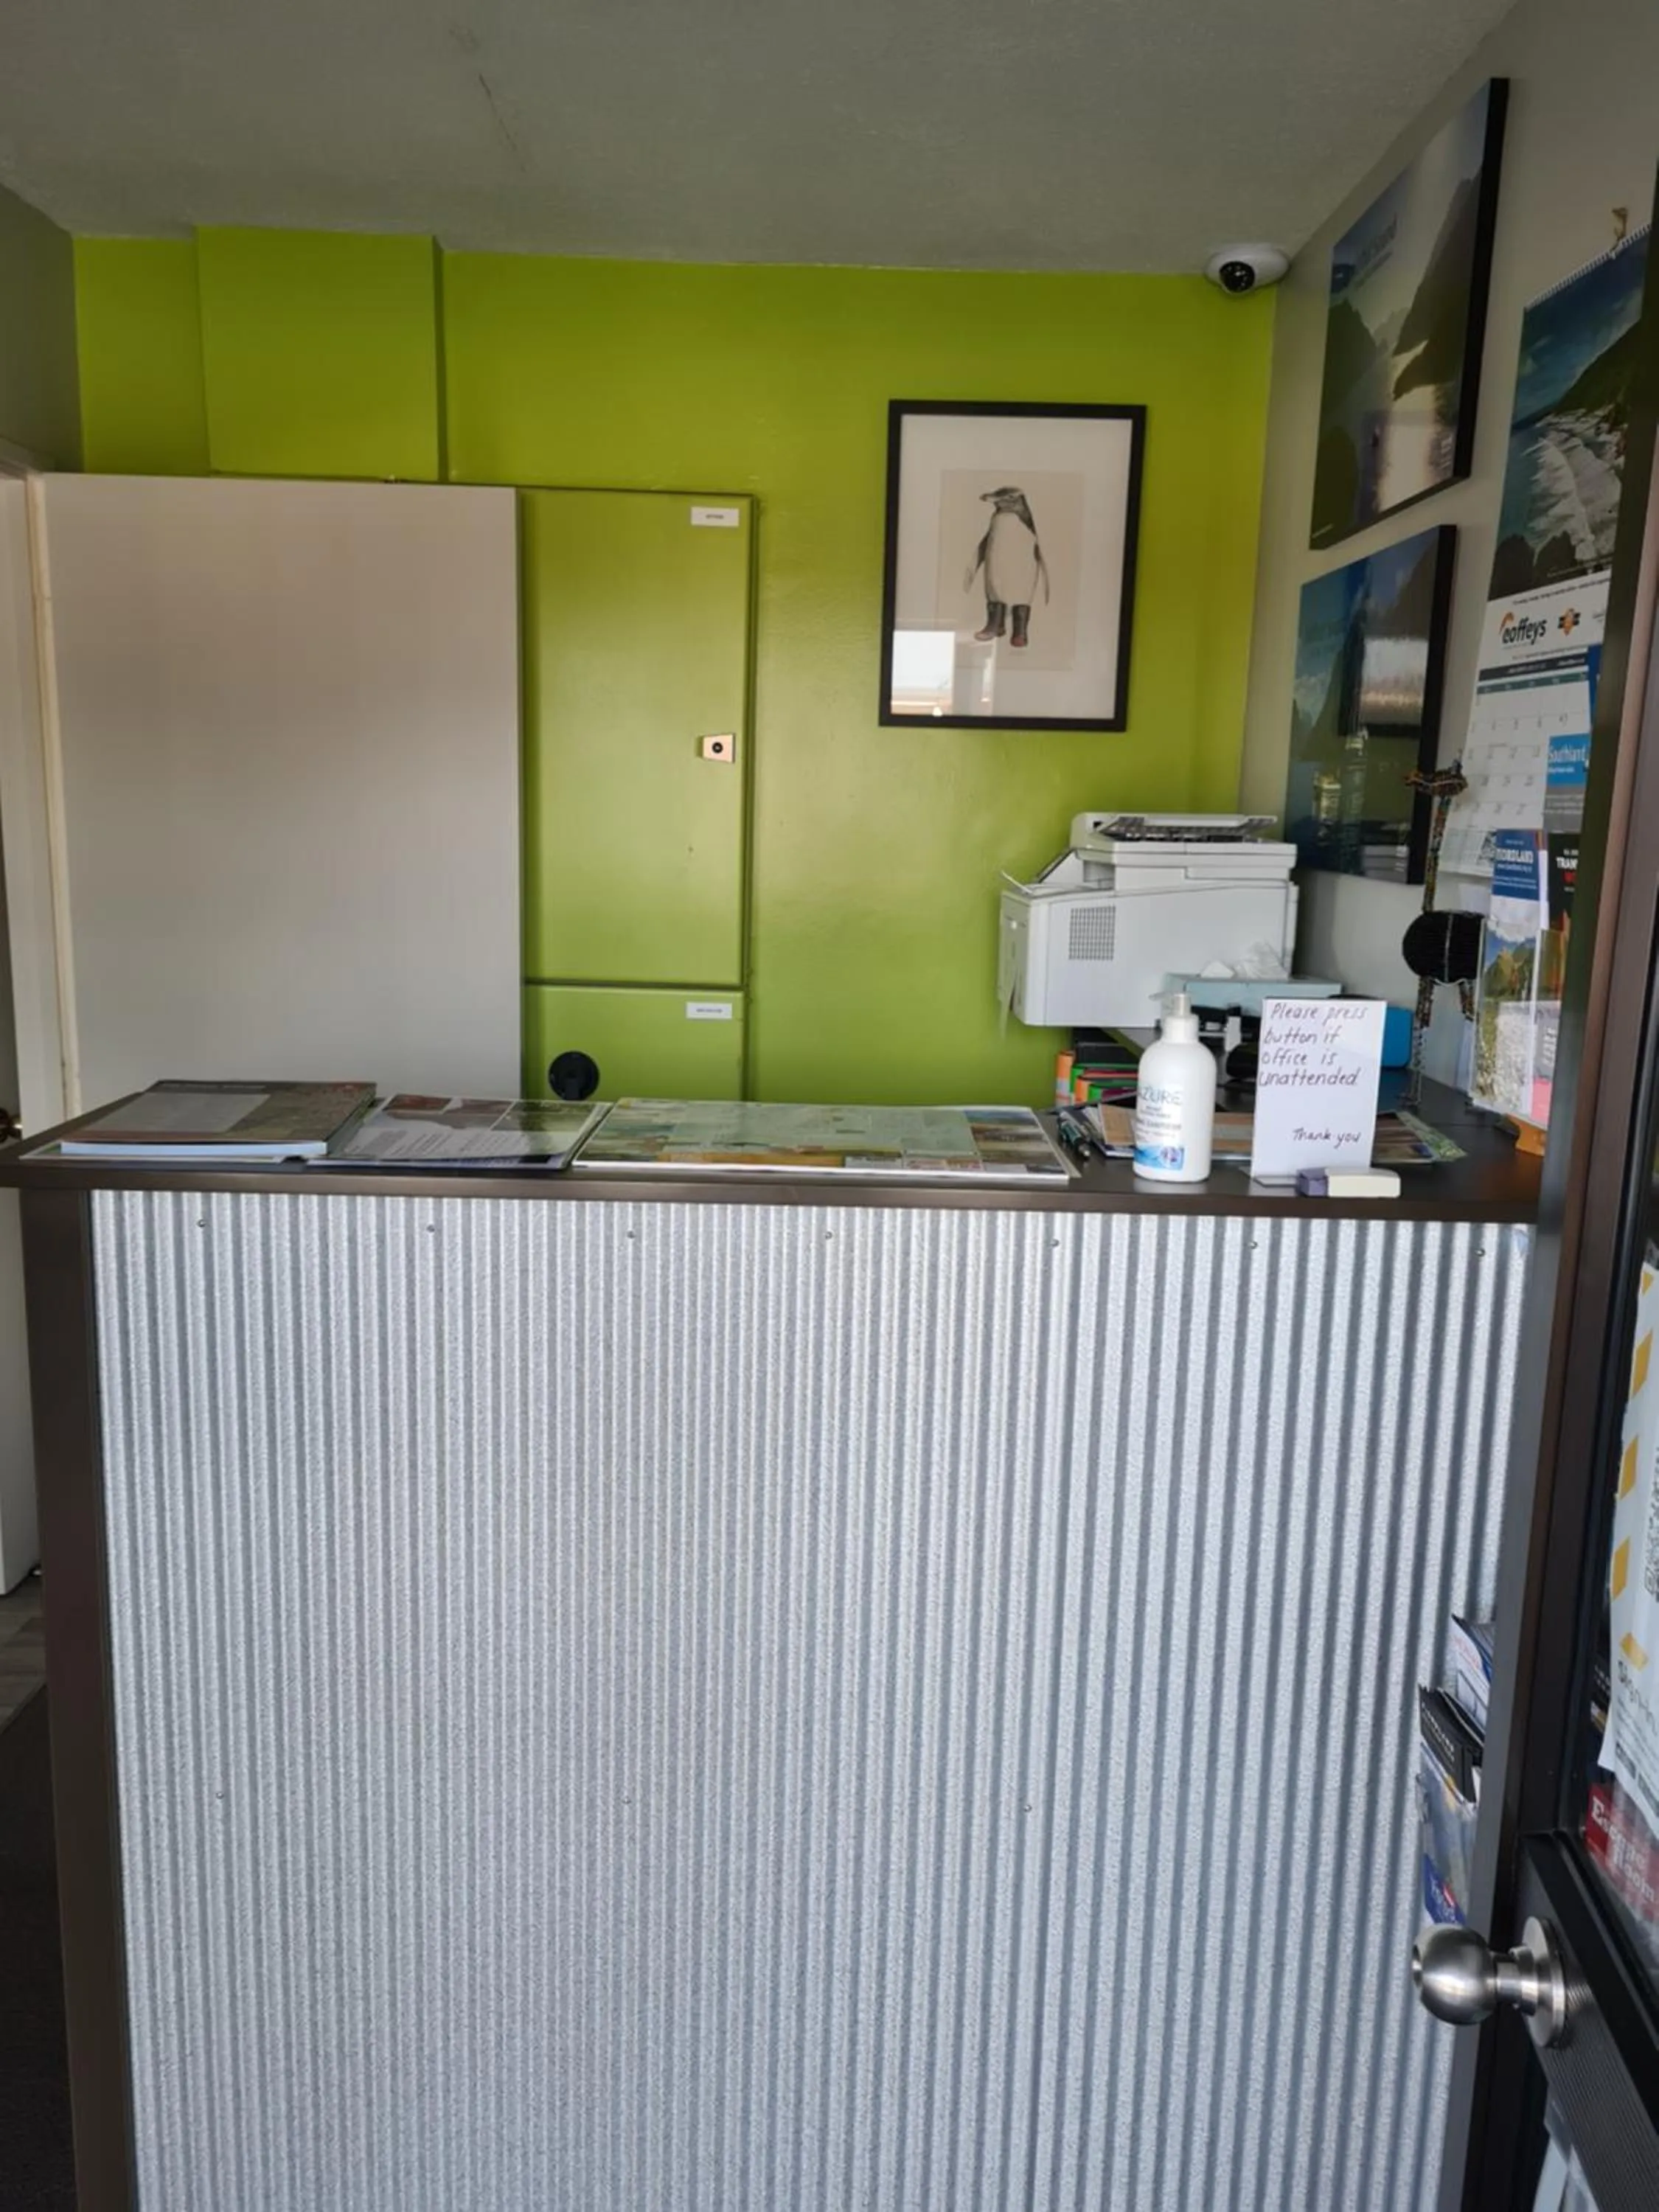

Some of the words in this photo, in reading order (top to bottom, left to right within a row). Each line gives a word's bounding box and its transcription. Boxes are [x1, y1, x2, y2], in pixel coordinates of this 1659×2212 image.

[1270, 1002, 1318, 1020] Please
[1322, 1006, 1368, 1026] press
[1264, 1026, 1318, 1044] button
[1324, 1026, 1342, 1044] if
[1321, 1048, 1338, 1065] is
[1293, 1126, 1332, 1141] Thank
[1332, 1132, 1362, 1150] you
